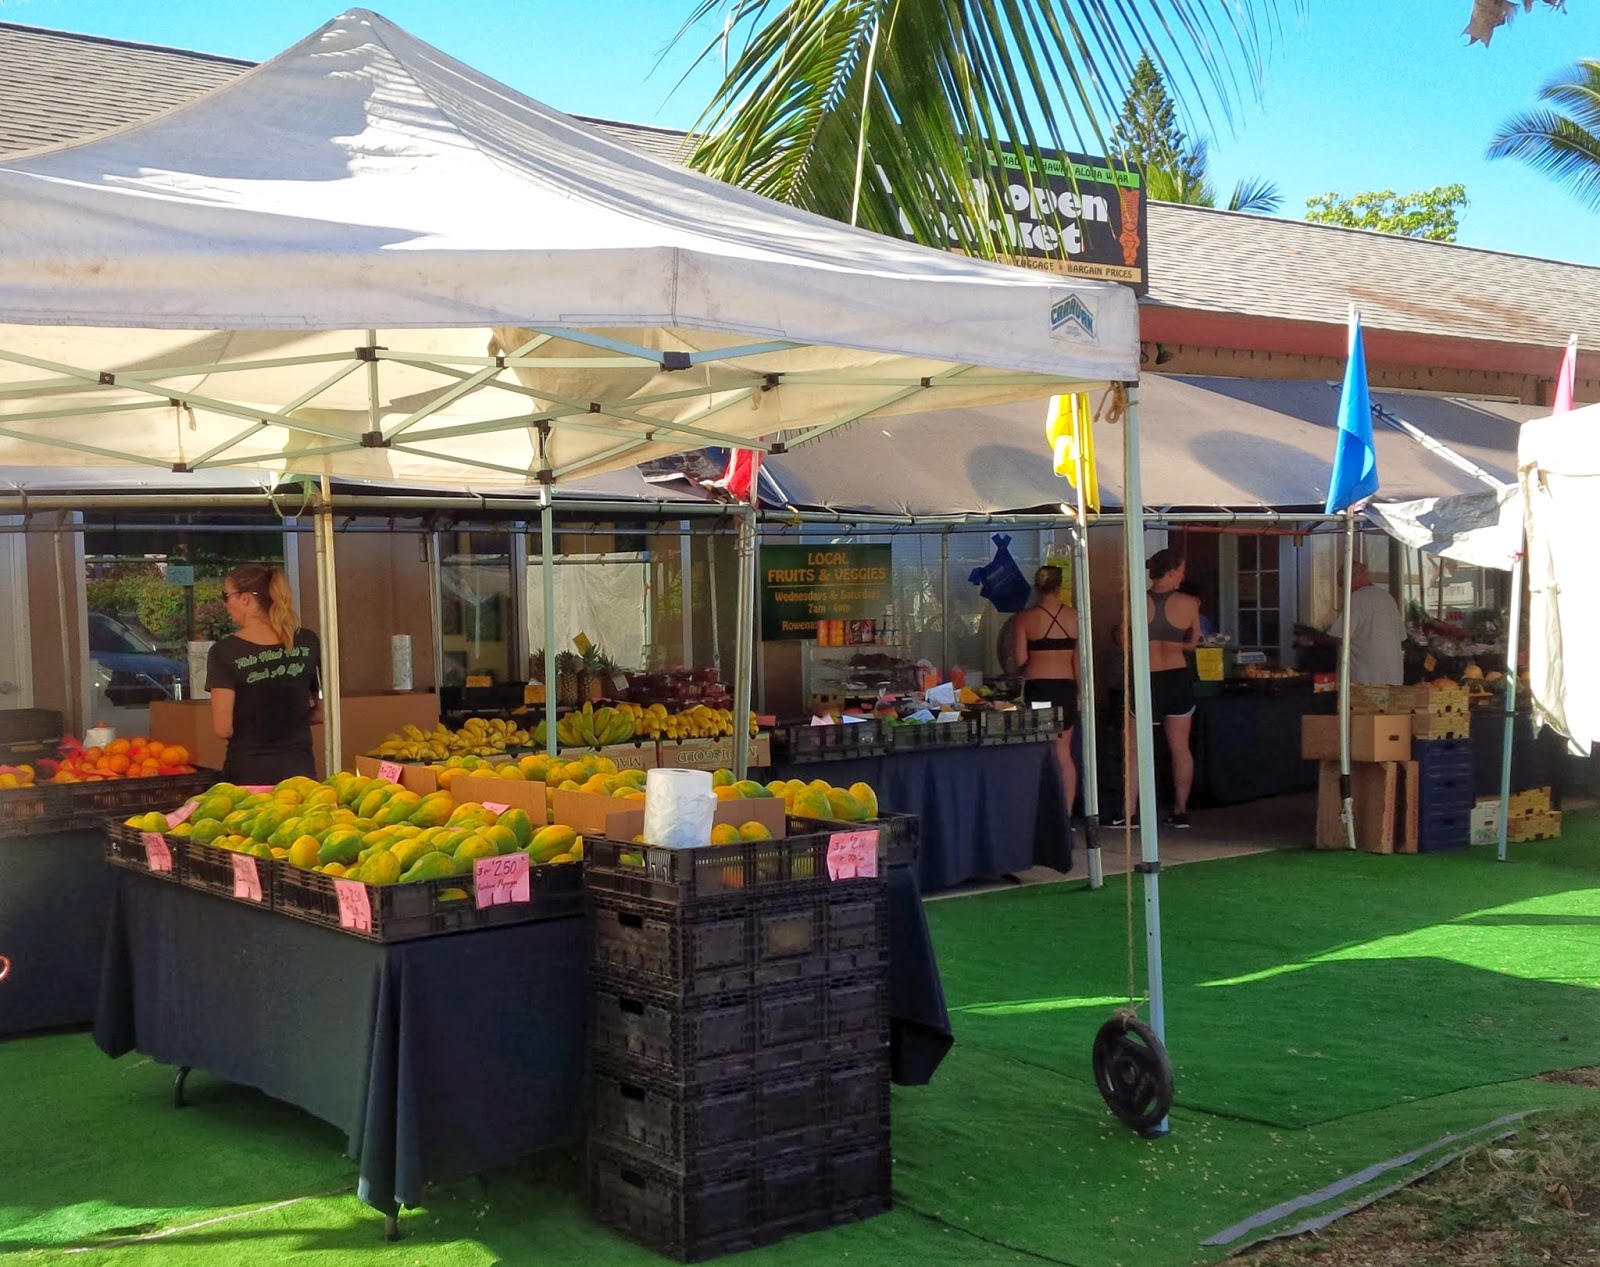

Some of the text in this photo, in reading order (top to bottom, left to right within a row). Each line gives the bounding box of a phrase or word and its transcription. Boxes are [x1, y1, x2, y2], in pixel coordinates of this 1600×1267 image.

[1002, 155, 1025, 168] MAD
[1106, 173, 1129, 184] WAR
[1004, 184, 1108, 223] open
[899, 207, 1082, 254] rket
[1067, 265, 1103, 275] BARGAIN
[1105, 268, 1133, 278] PRICES
[808, 552, 849, 566] LOCAL
[767, 567, 886, 583] FRUITS & VEGGIES
[774, 591, 827, 602] Wednesdays
[829, 590, 839, 600] &
[808, 603, 826, 614] 7am
[614, 756, 642, 769] MAU
[677, 750, 714, 764] GOLD
